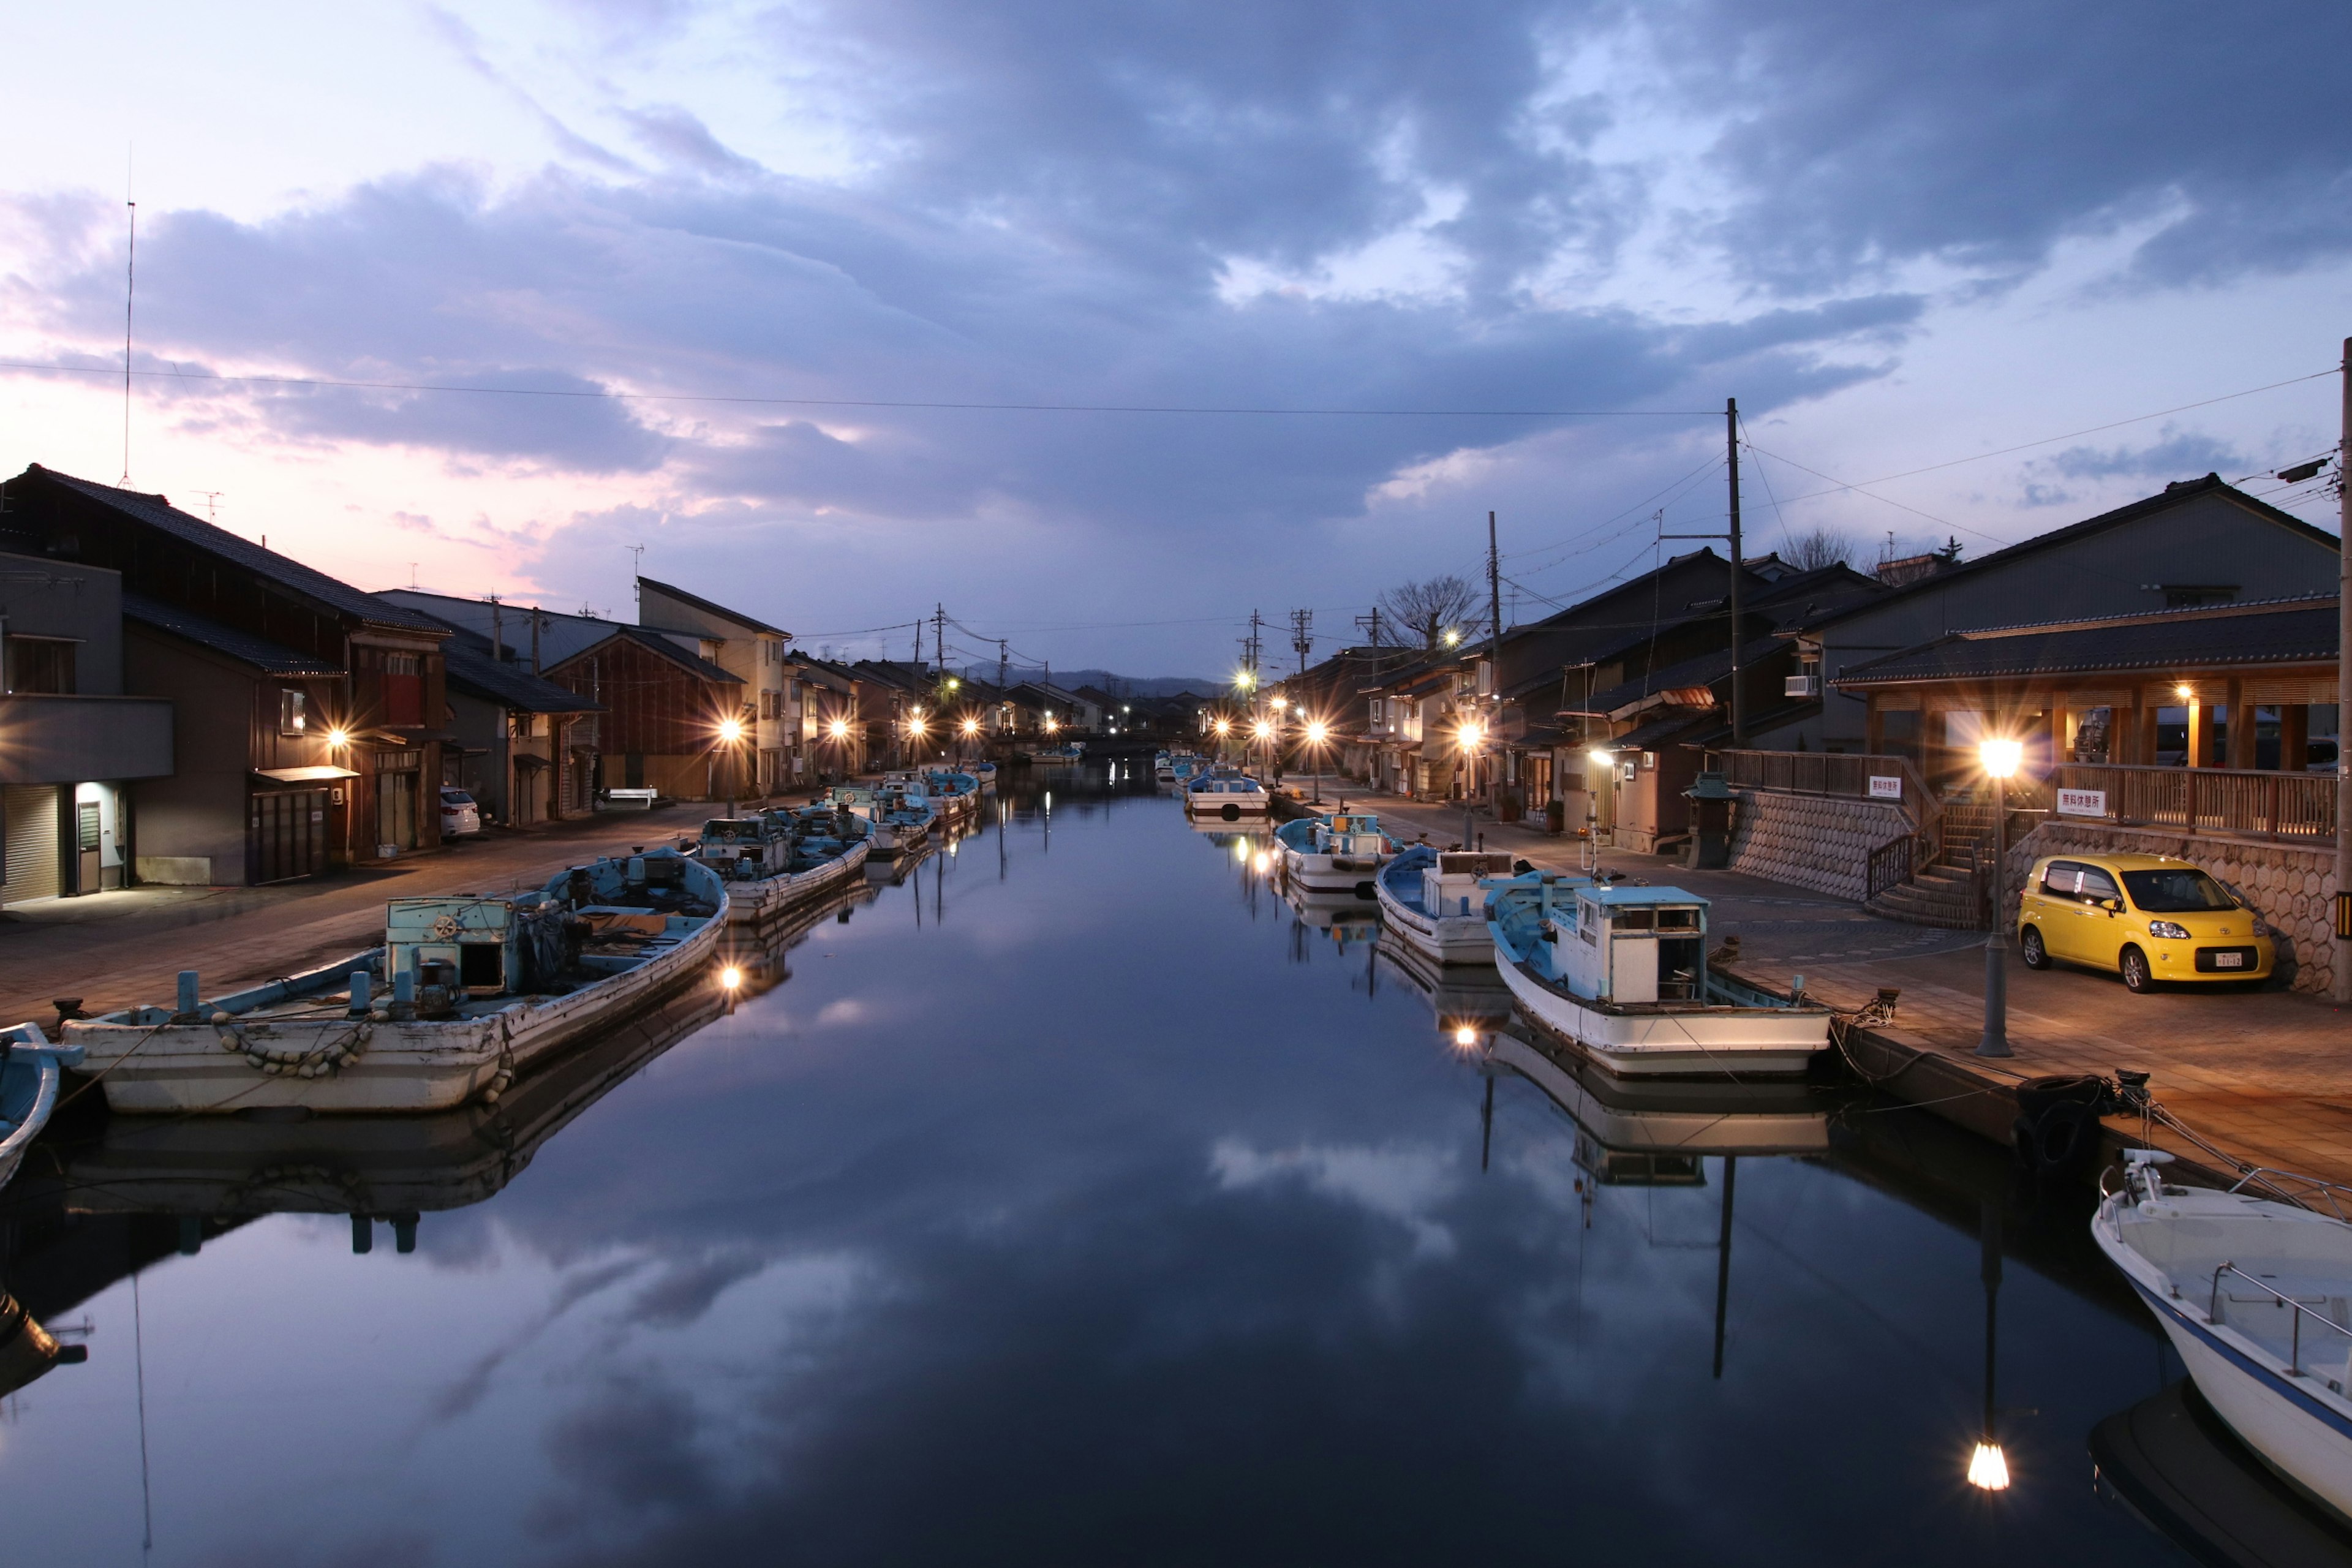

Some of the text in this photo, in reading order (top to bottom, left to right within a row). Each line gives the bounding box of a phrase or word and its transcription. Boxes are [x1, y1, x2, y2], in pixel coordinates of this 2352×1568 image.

[2063, 794, 2098, 808] 無料休憩所
